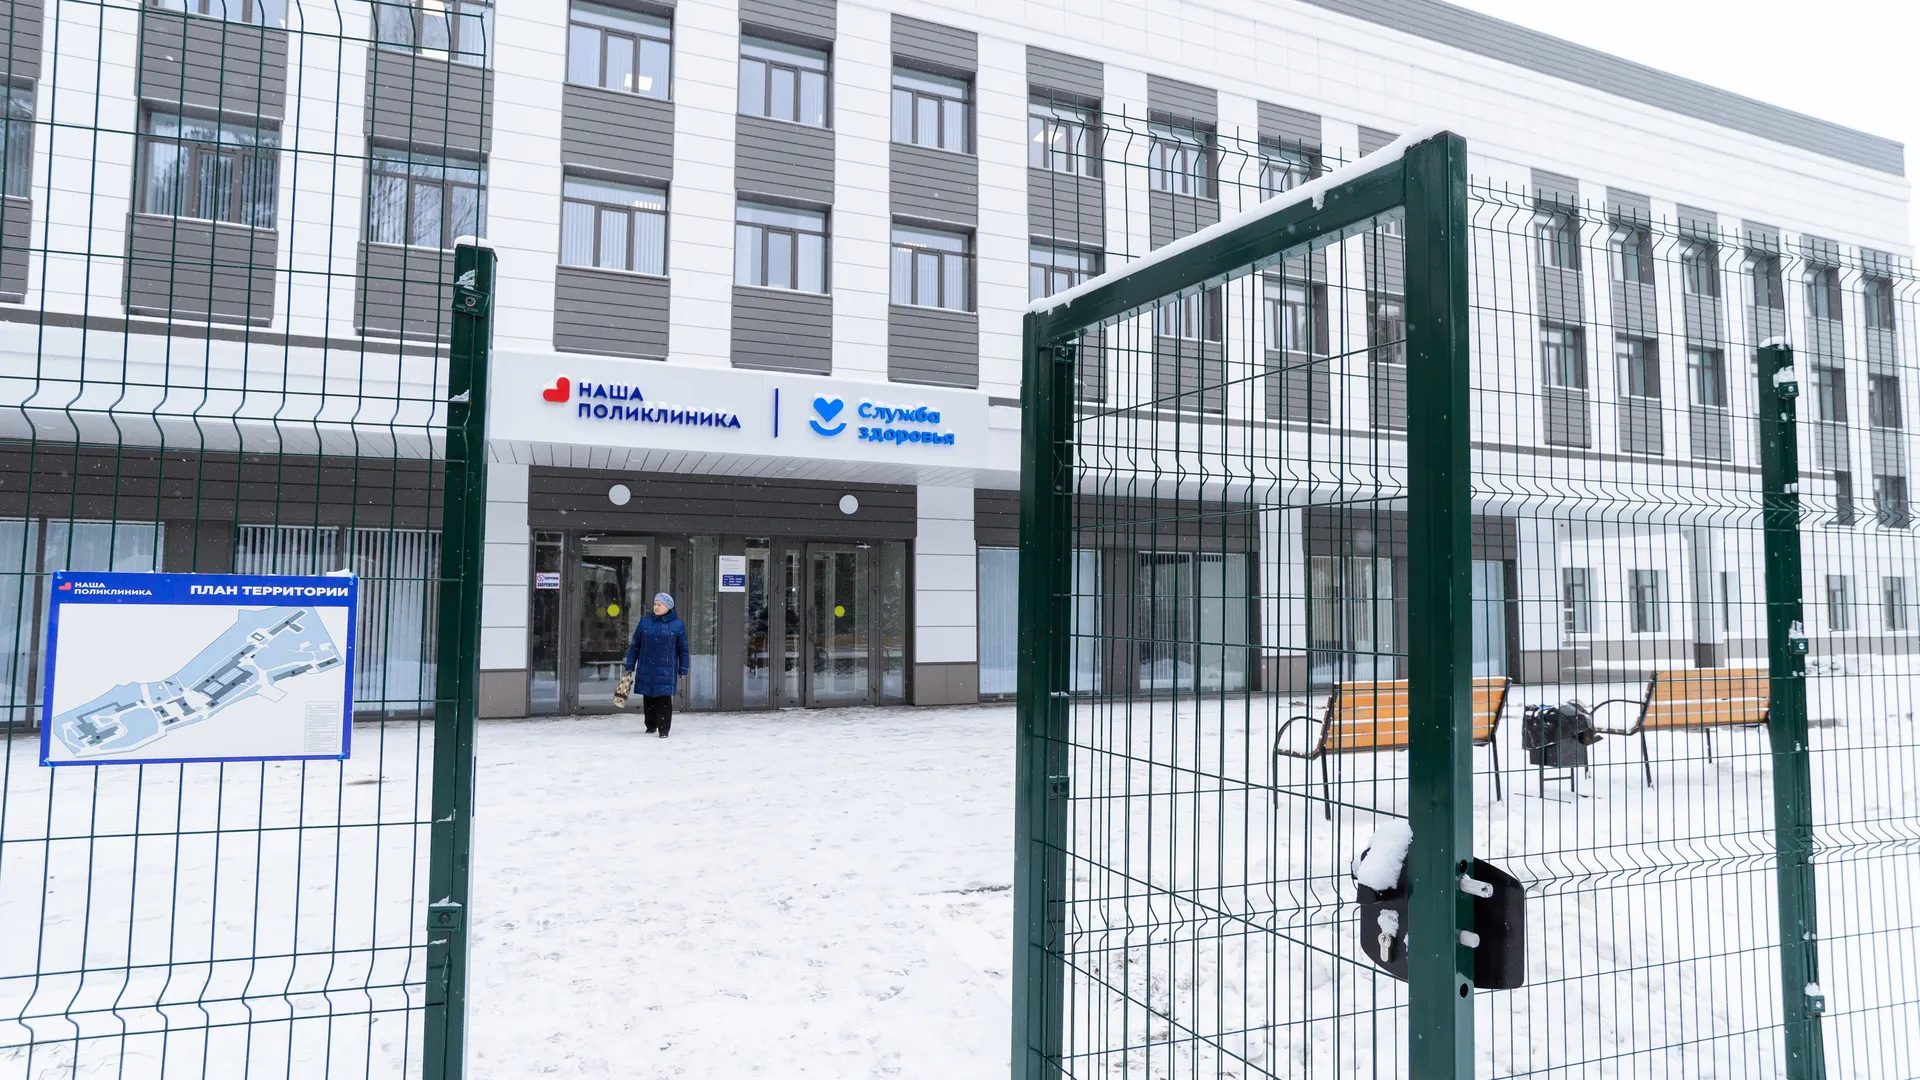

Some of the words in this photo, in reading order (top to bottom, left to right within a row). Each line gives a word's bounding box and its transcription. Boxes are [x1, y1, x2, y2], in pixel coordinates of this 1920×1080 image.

[578, 381, 644, 401] НАША
[578, 402, 741, 429] ПОЛИКЛИНИКА
[858, 402, 941, 424] Служба
[858, 426, 955, 445] здоровья
[74, 588, 152, 596] ПОЛИКЛИНИКА
[190, 585, 238, 595] ПЛАН
[242, 586, 349, 597] ТЕРРИТОРИИ
